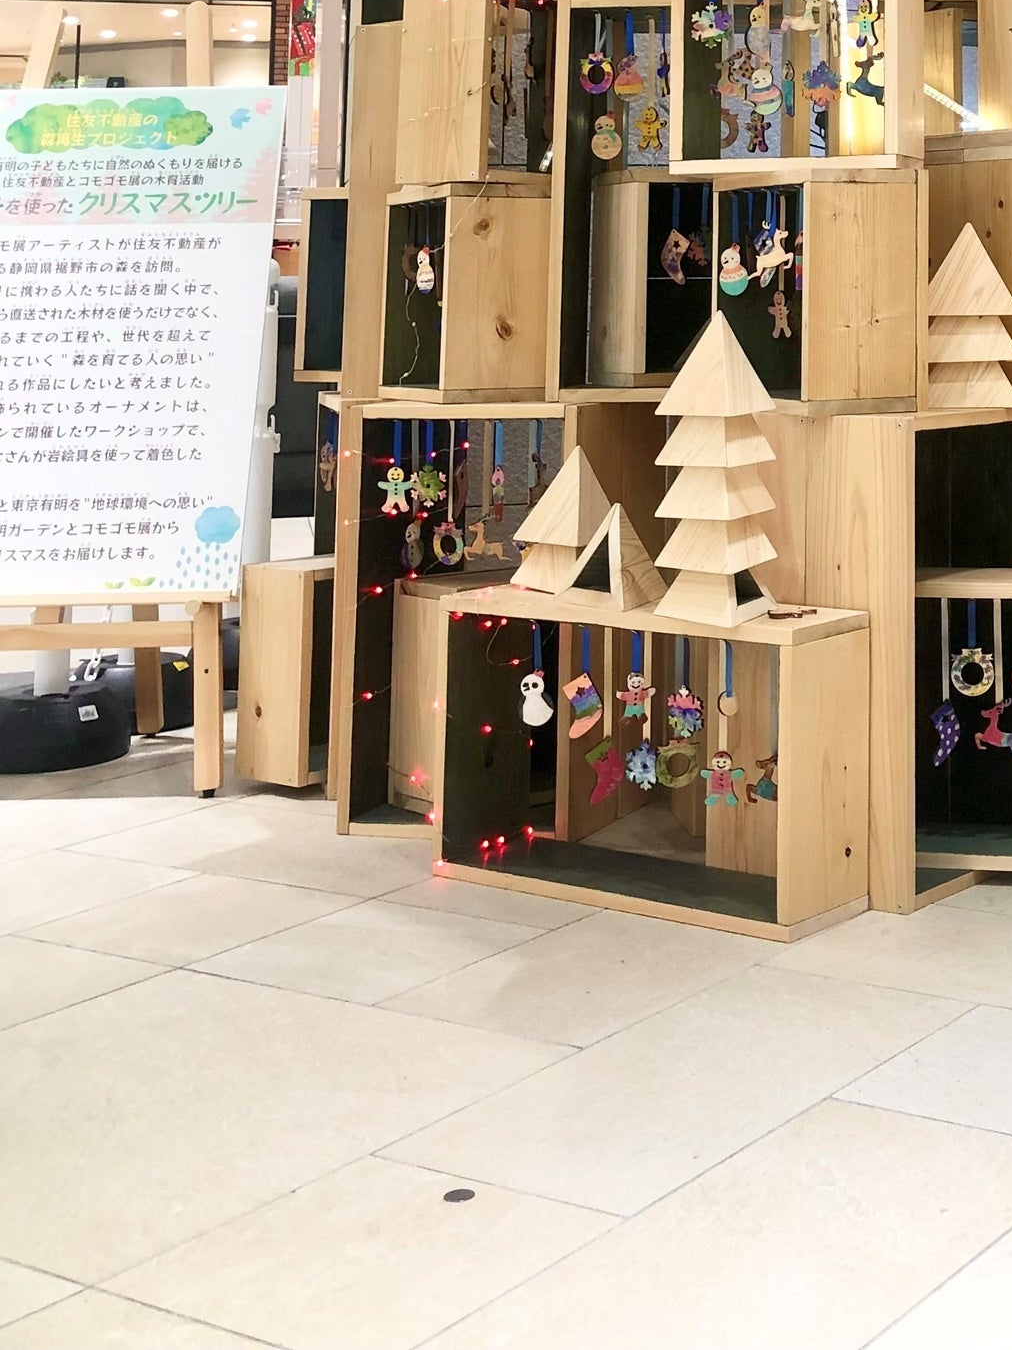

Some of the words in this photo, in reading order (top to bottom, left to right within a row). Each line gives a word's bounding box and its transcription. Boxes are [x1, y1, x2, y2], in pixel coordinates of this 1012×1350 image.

[66, 113, 158, 128] 住友不動産の
[0, 158, 243, 172] 明の子どもたちに自然のぬくもりを届ける
[0, 283, 219, 298] に携わる人たちに話を聞く中で、
[0, 376, 211, 391] る作品にしたいと考えました。
[0, 448, 202, 463] さんが岩絵具を使って着色した
[0, 546, 156, 562] スマスをお届けします。
